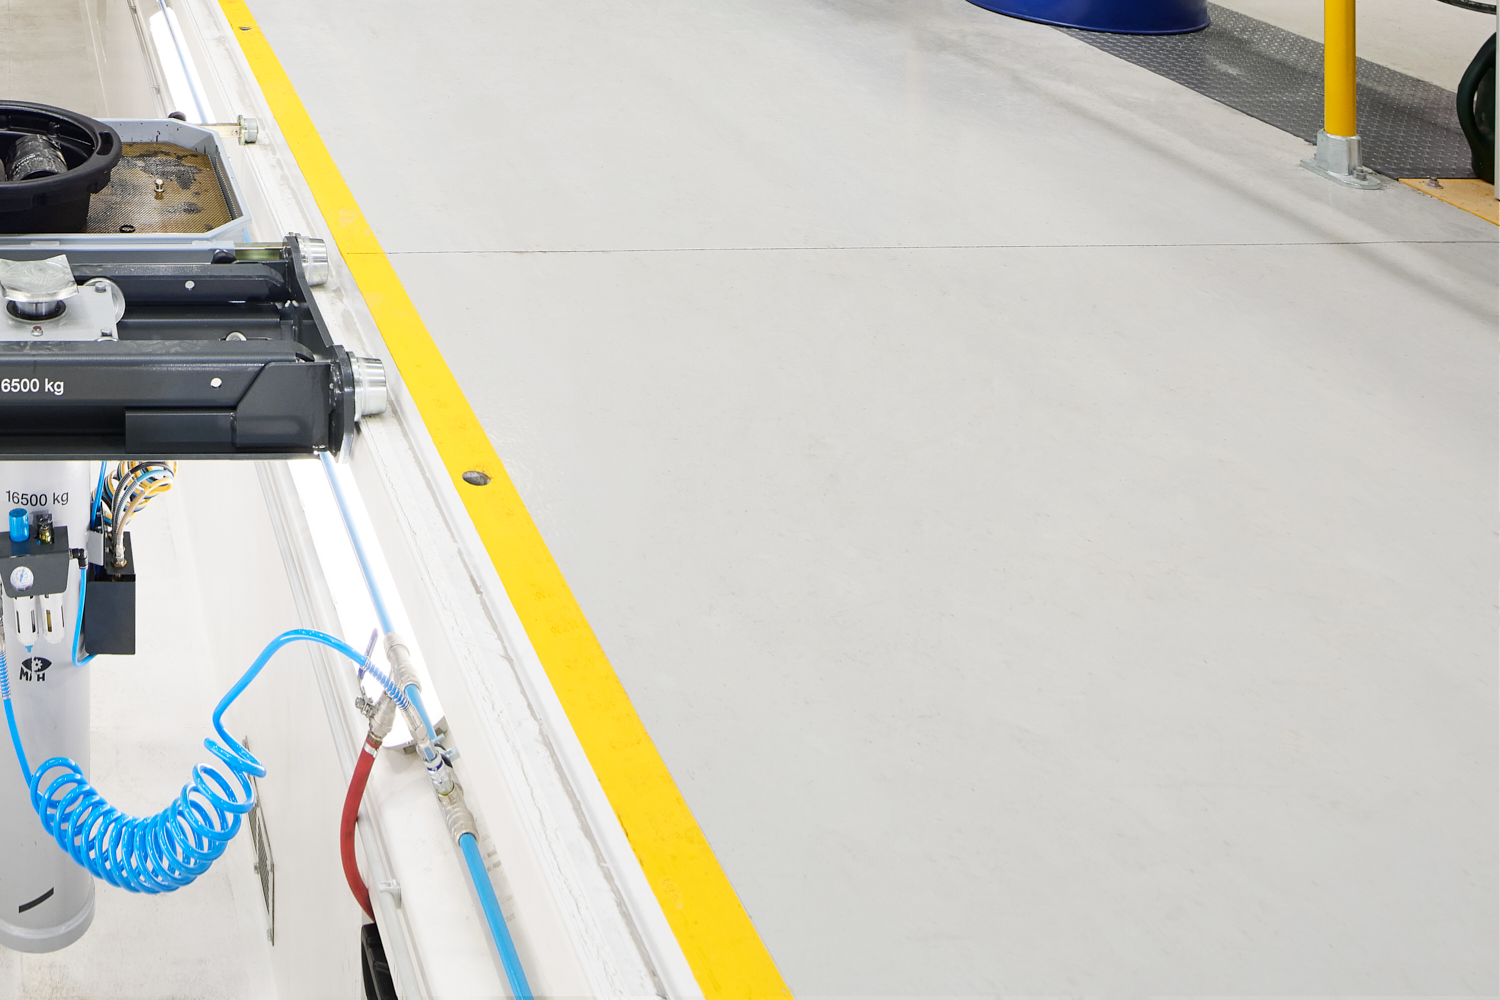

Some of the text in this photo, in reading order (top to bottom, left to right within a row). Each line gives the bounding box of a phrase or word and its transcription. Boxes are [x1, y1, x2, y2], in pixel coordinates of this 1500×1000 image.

[44, 377, 64, 396] kg
[5, 490, 69, 507] 16500 kg
